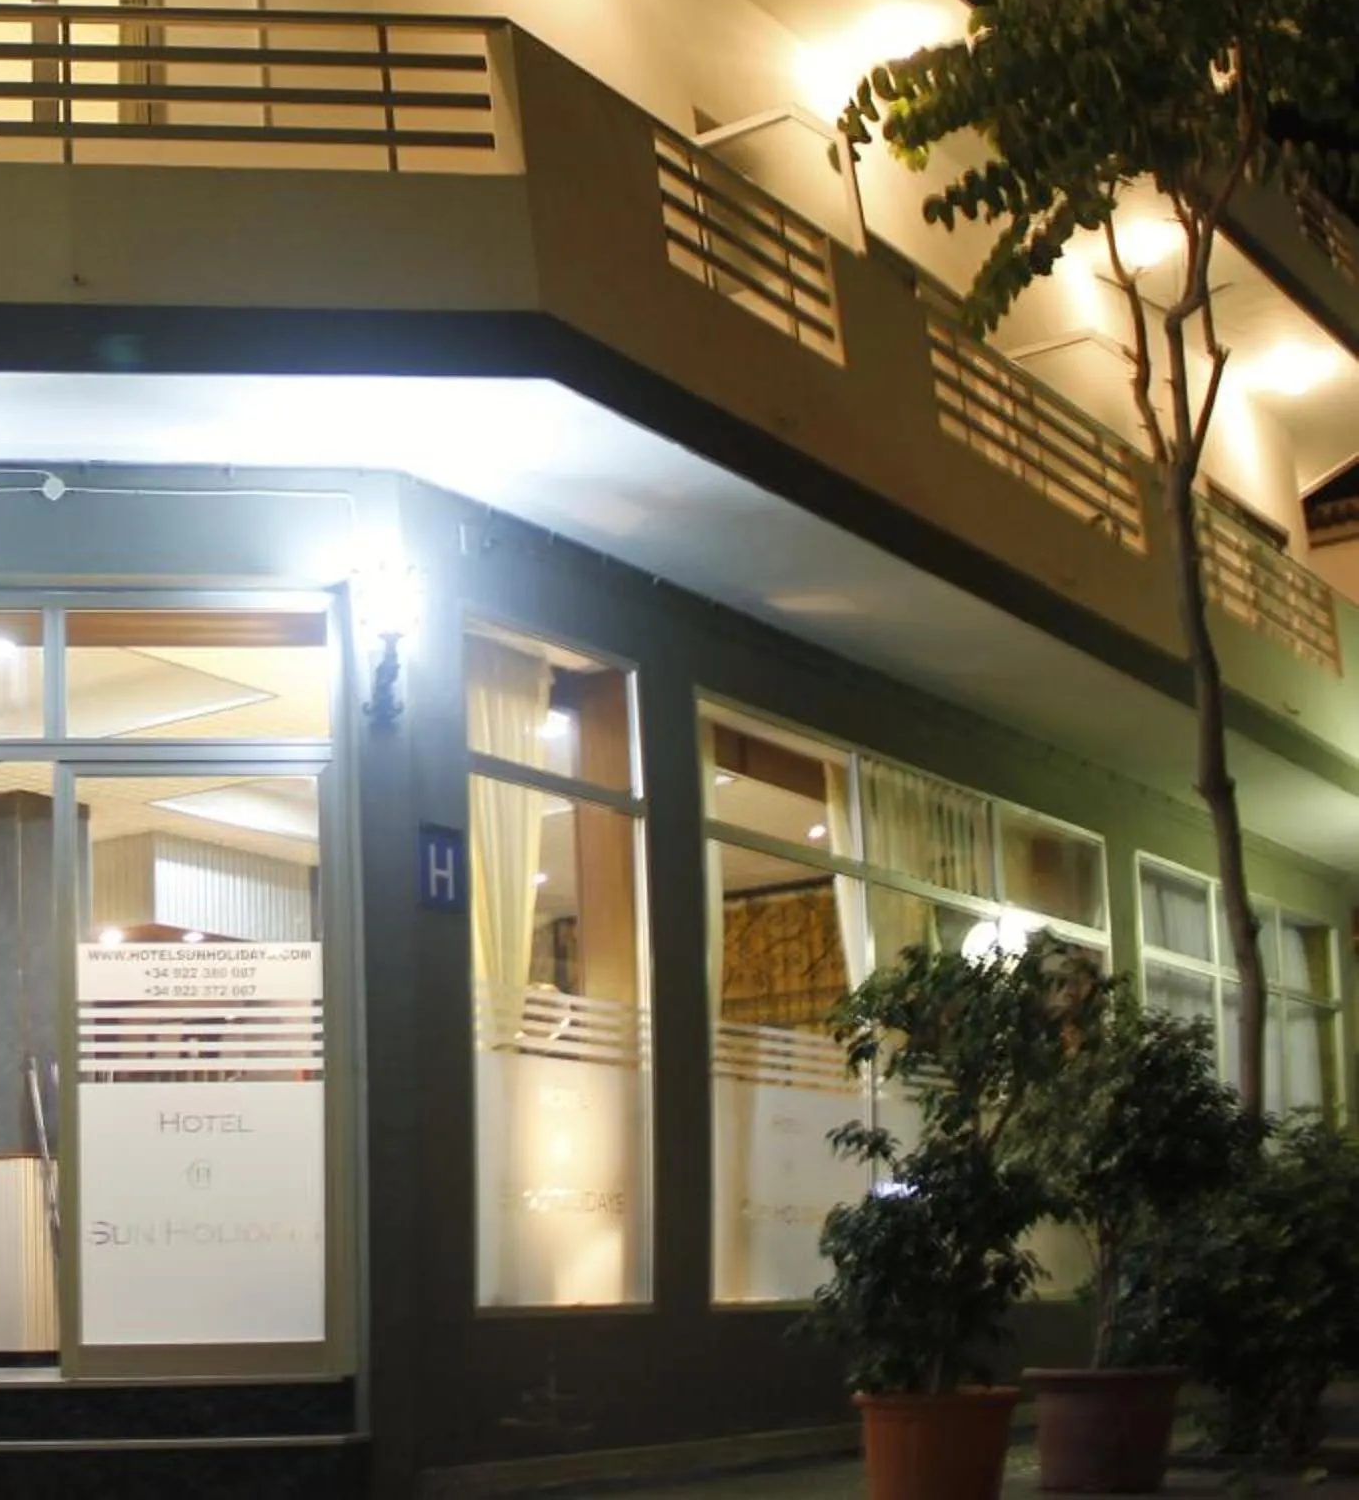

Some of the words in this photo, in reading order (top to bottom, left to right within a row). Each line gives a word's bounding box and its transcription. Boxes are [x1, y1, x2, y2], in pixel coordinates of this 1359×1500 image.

[429, 843, 454, 901] H
[160, 1111, 255, 1133] HOTEL
[91, 1220, 157, 1245] SUN
